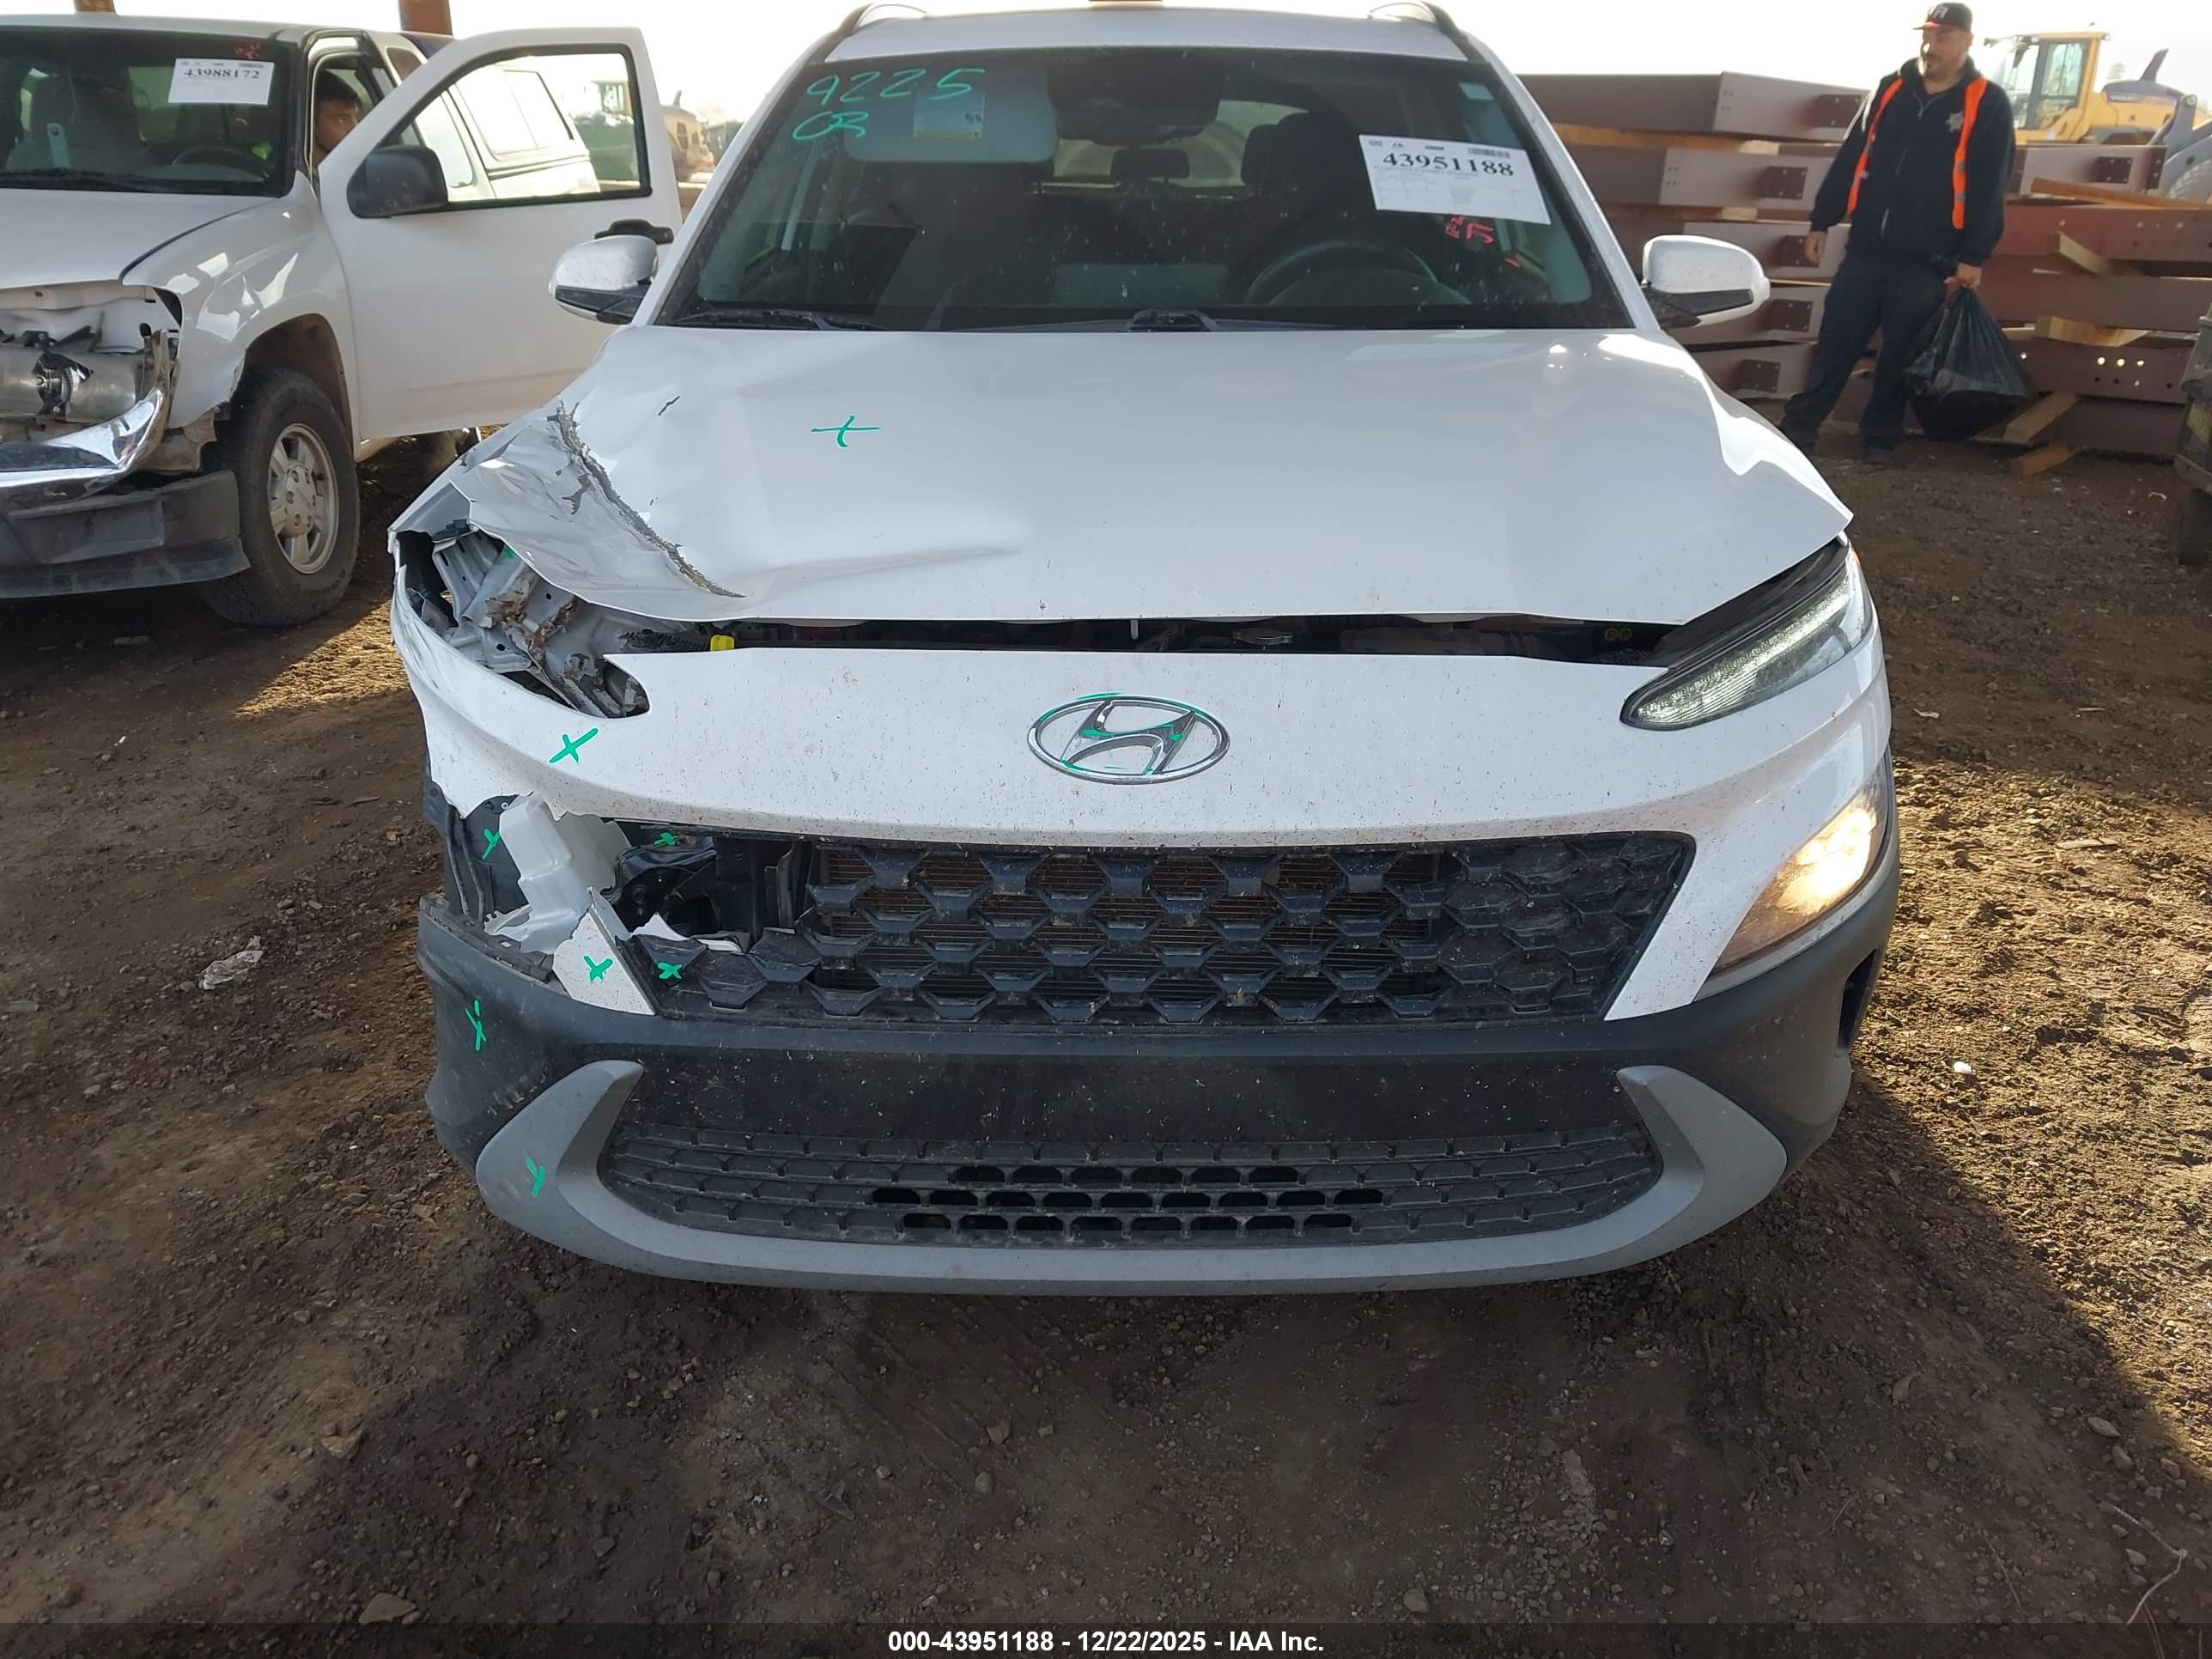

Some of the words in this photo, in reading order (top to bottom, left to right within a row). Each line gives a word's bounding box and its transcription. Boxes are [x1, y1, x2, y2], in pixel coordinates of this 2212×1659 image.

[184, 68, 260, 79] 43988172
[805, 68, 986, 106] 9225
[1383, 151, 1514, 177] 43951188
